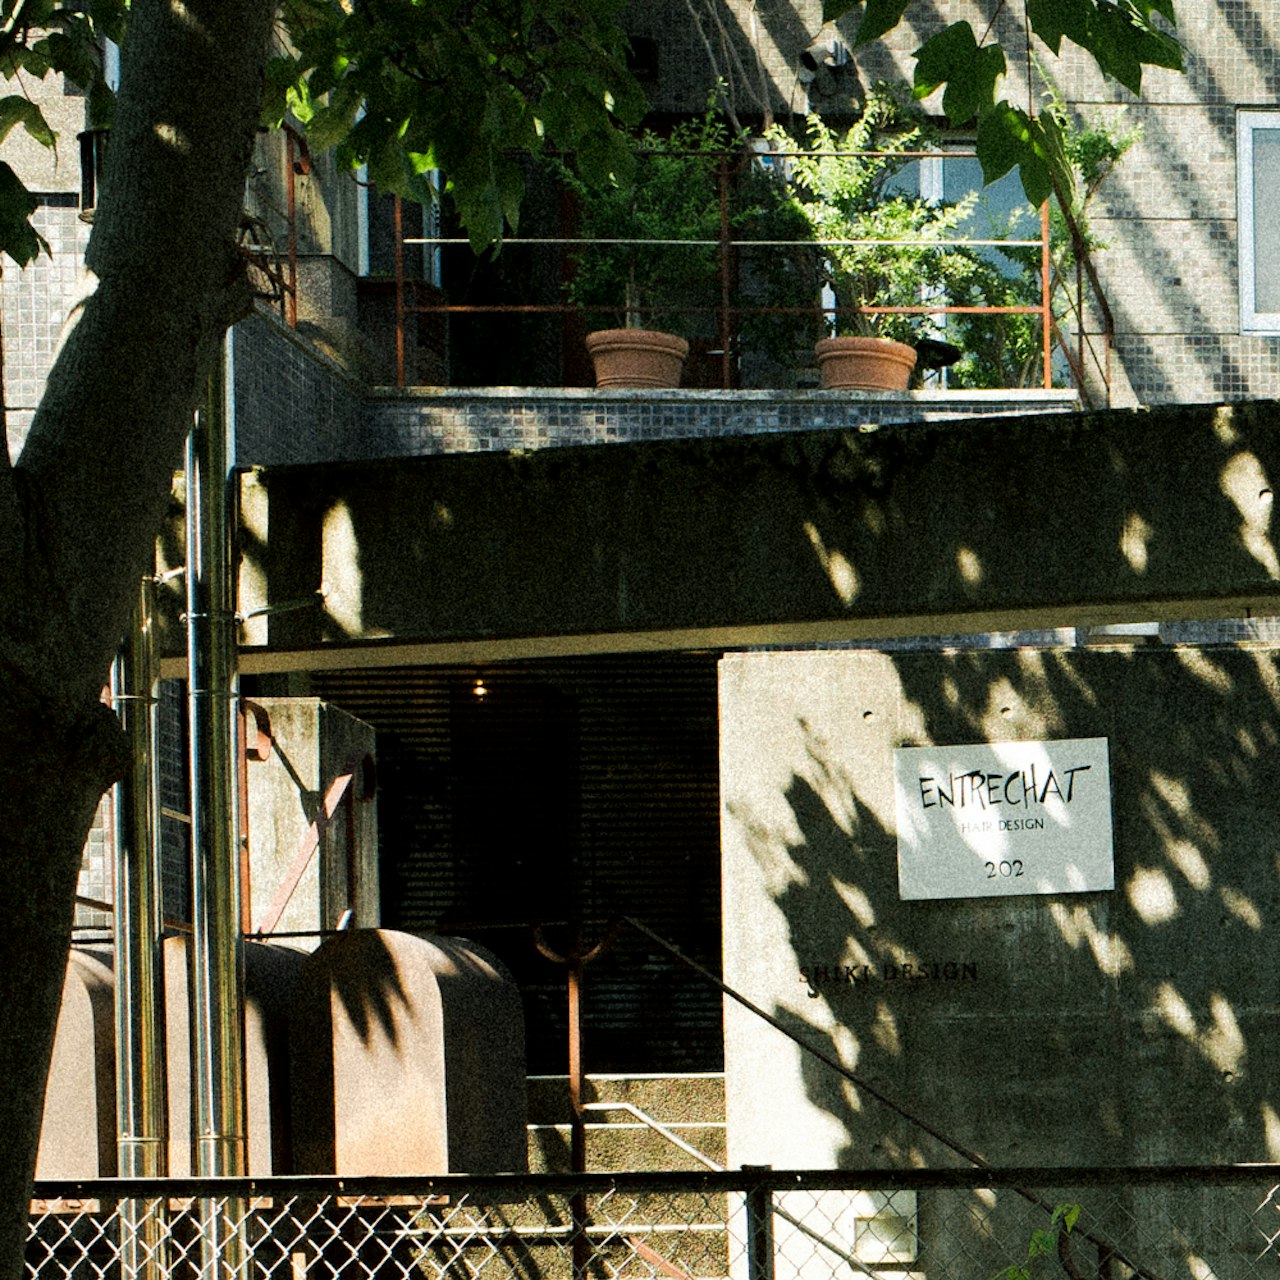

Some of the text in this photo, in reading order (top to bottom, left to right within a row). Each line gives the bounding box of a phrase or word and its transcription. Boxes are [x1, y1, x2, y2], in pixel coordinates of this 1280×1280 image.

[919, 763, 1091, 809] ENTRECHAT
[961, 818, 1044, 833] HAIR DESIGN
[985, 860, 1024, 879] 202
[883, 961, 978, 982] DESIGN
